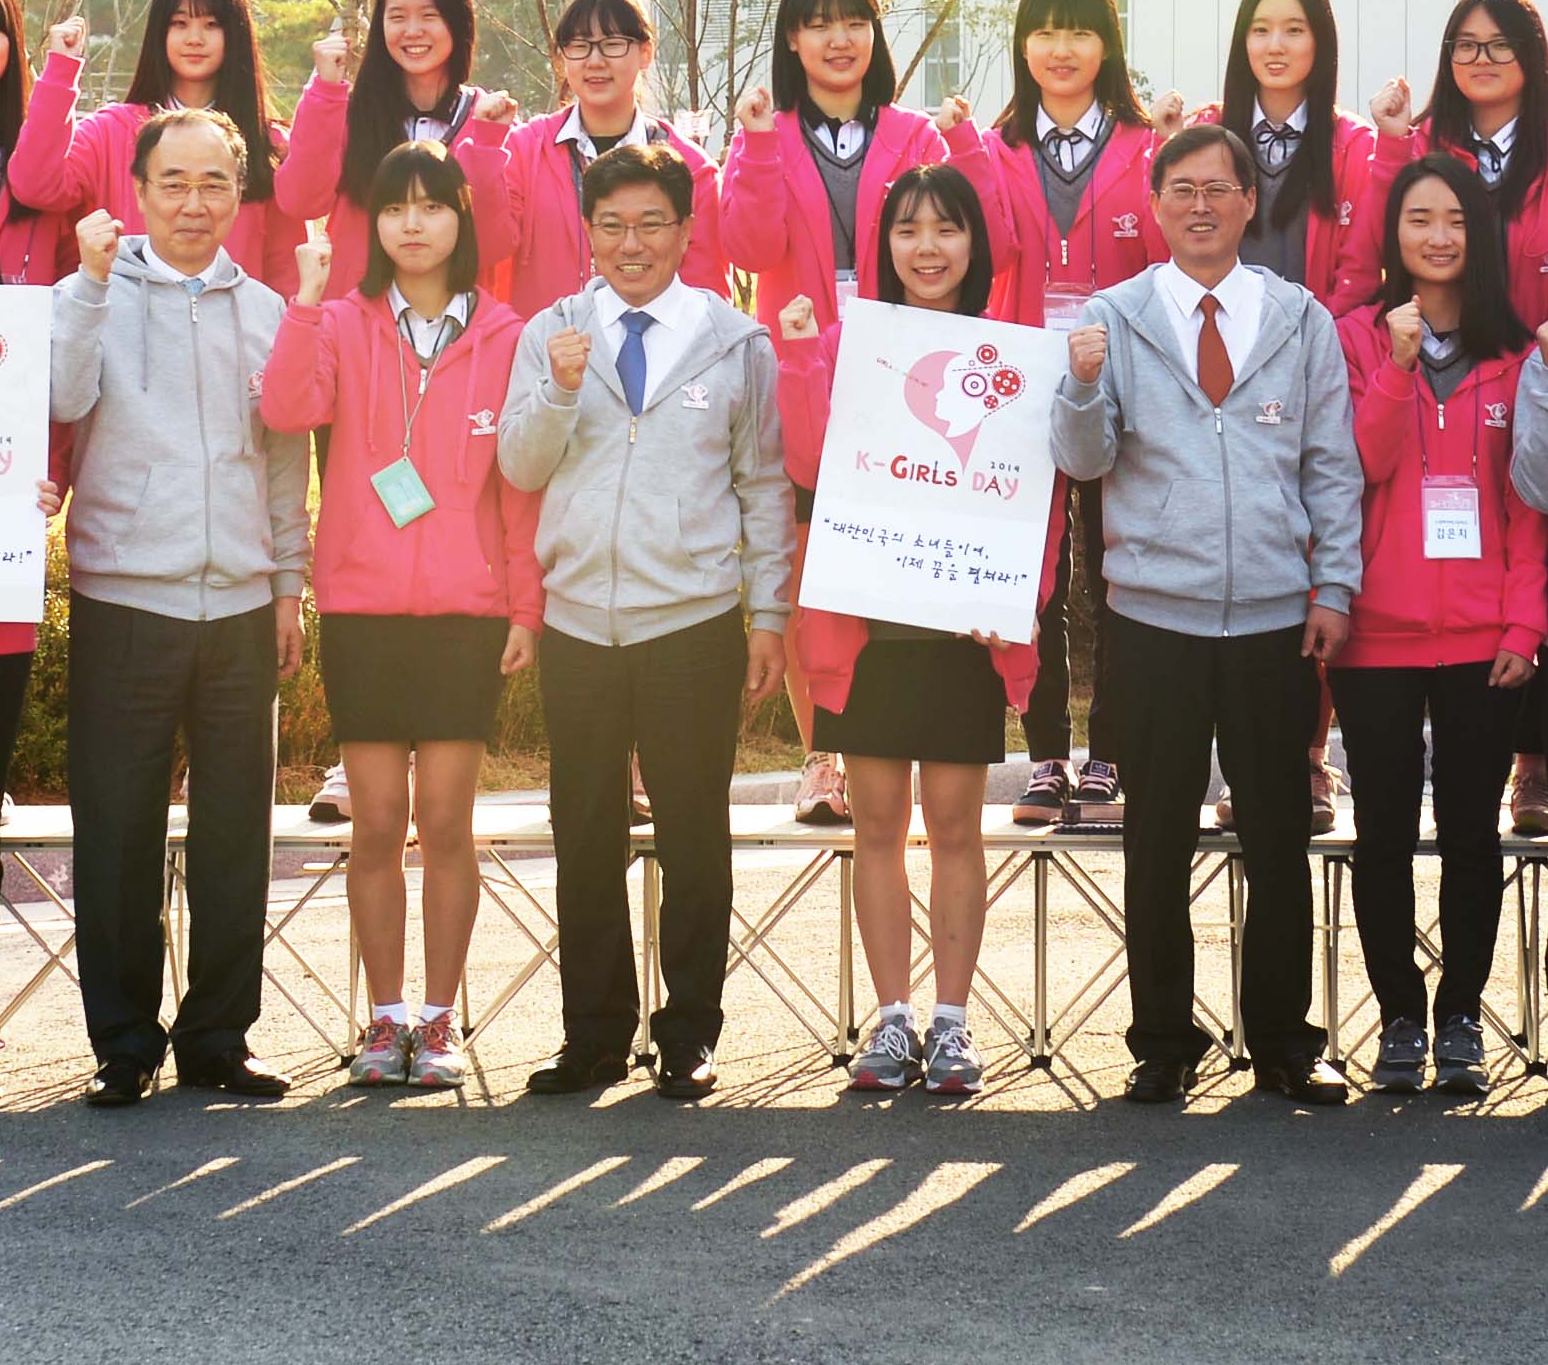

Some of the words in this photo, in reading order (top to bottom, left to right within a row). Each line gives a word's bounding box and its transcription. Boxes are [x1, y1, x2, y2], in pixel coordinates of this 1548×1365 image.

[972, 471, 1019, 500] DAY
[895, 556, 924, 570] 이제
[932, 561, 958, 581] 꿈을
